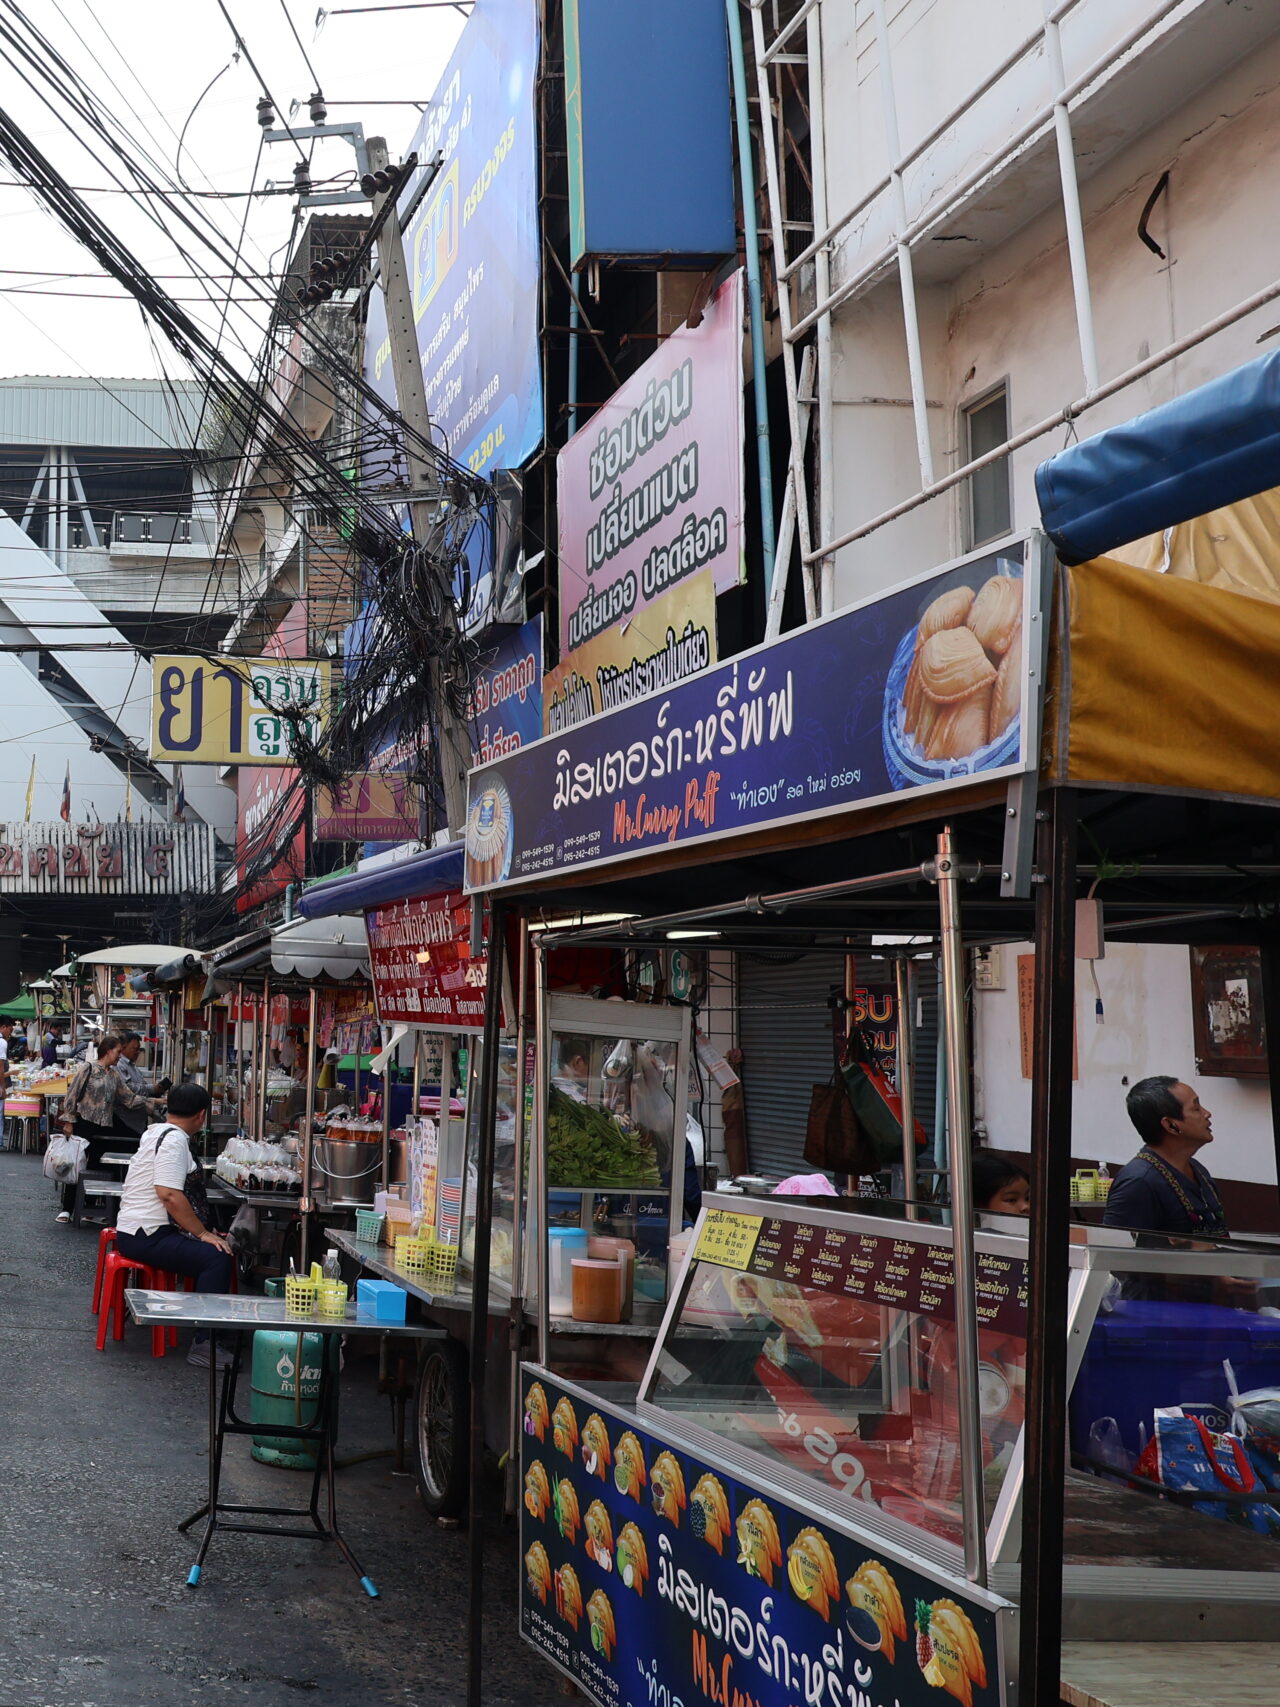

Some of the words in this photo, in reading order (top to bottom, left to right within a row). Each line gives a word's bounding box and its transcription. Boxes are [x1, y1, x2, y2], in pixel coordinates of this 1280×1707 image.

[590, 359, 693, 497] ซ่อมด่วน
[586, 440, 699, 575] เปลี่ยนแบต
[568, 573, 636, 651] เปลี่ยนจอ
[642, 507, 727, 601] ปลดล็อค
[492, 653, 537, 705] ราคาถูก
[158, 666, 243, 754] ยา
[684, 770, 721, 828] Puff
[830, 768, 862, 790] อร่อย
[530, 1609, 570, 1649] 099-549-1539
[531, 1626, 570, 1666] 095-242-4515
[579, 1650, 620, 1696] 099-549-1539
